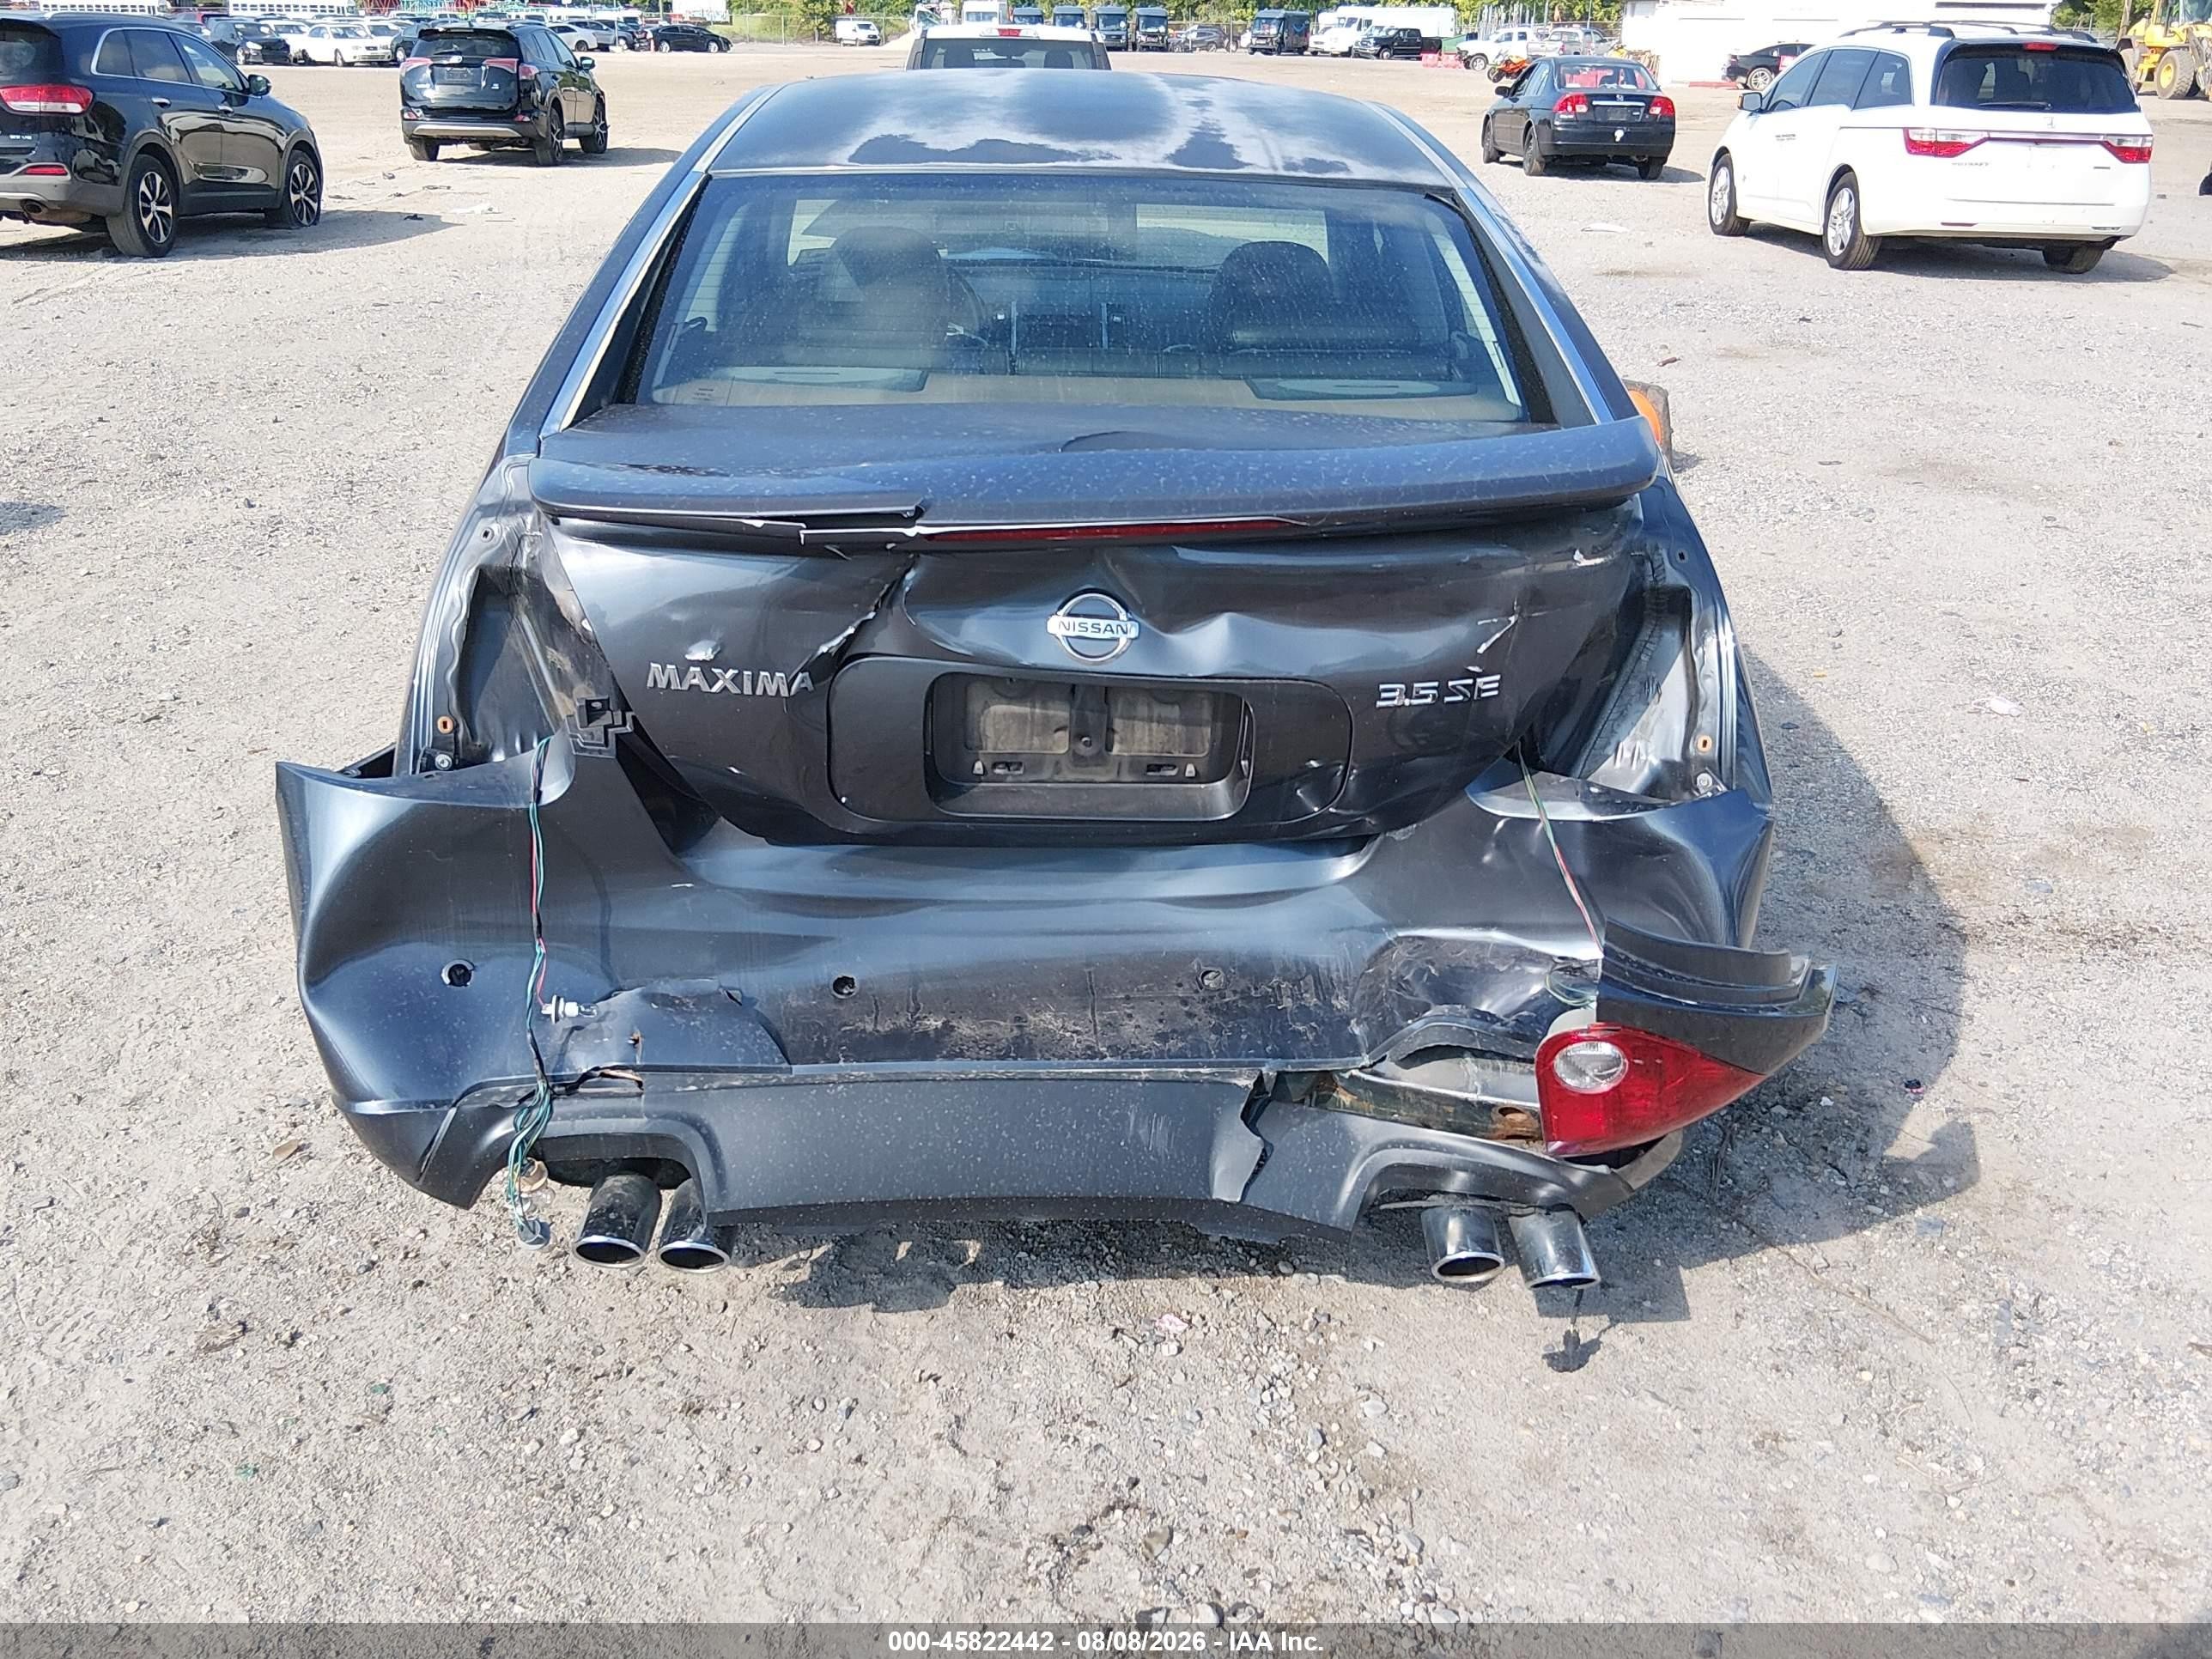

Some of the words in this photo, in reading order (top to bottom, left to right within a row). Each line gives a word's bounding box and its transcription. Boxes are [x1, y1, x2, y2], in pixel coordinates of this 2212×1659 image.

[1058, 621, 1128, 635] NISSAN
[647, 662, 814, 697] MAXIMA
[1376, 681, 1439, 708] 3.5
[1443, 674, 1501, 703] SE
